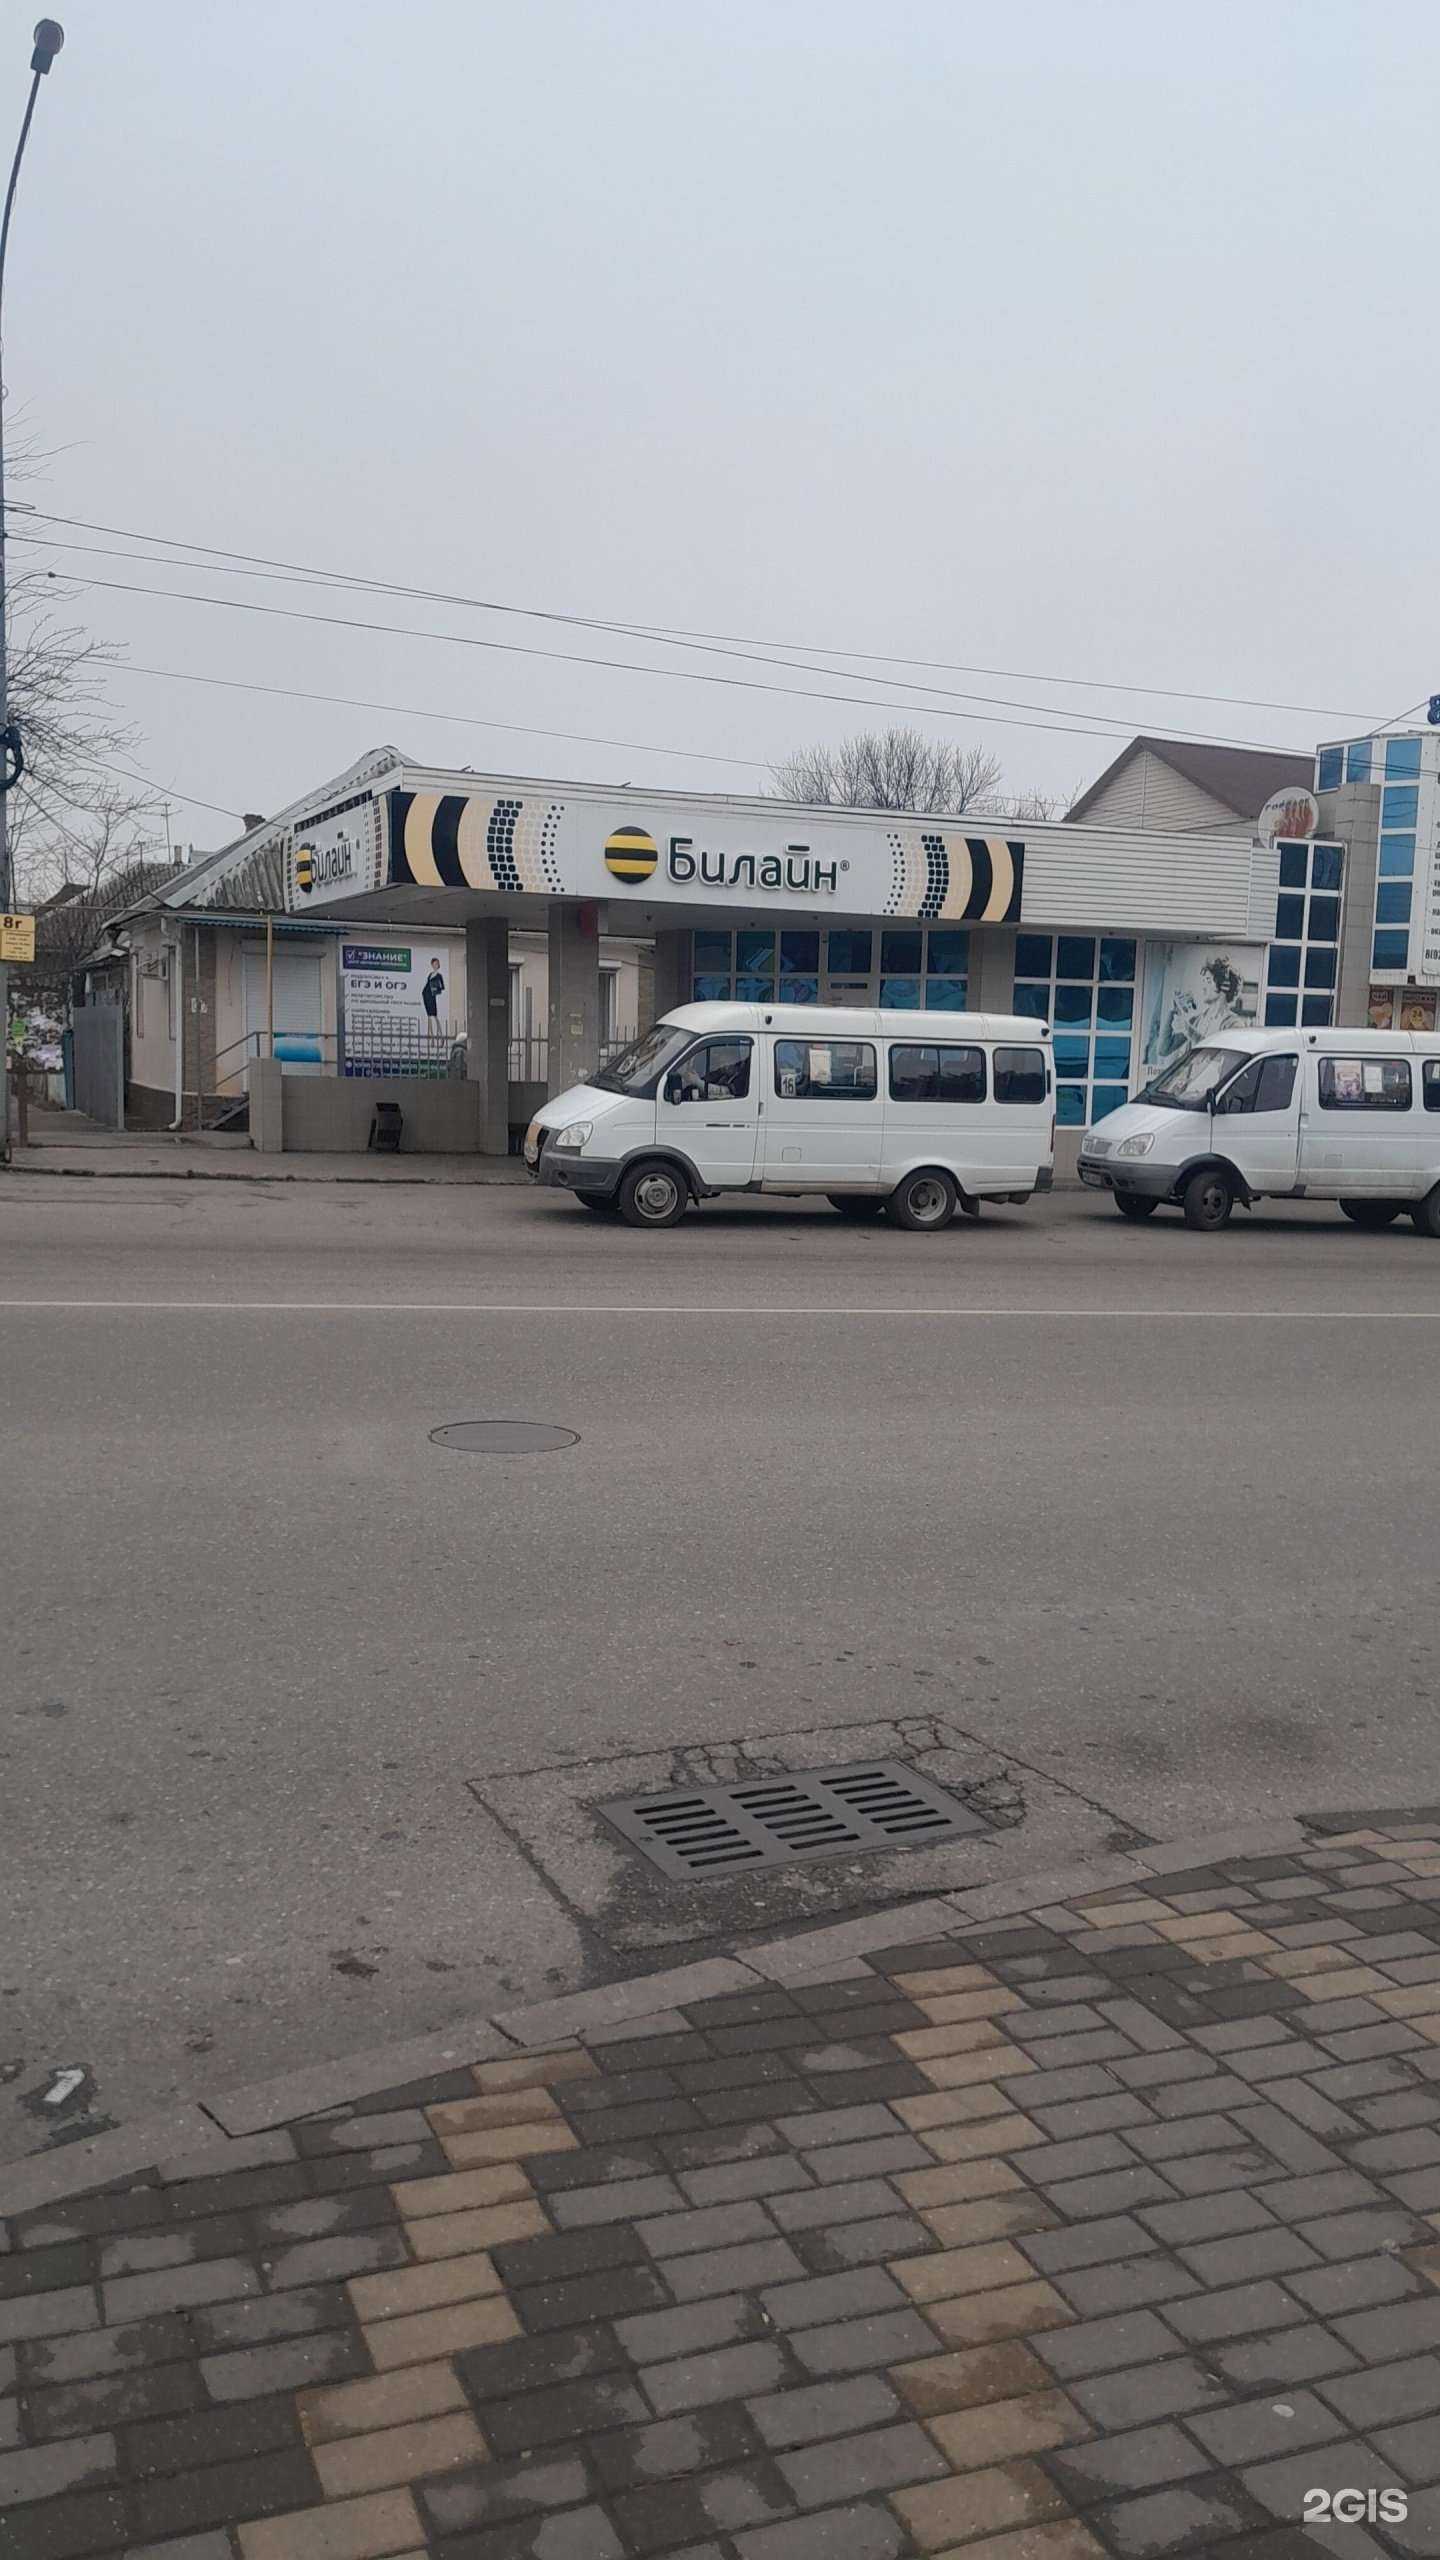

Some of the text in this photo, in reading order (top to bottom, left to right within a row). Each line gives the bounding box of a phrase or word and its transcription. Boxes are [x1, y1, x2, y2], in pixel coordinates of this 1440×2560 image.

[351, 979, 408, 991] ЕГЭ И ОГЭ
[782, 1076, 794, 1094] 16
